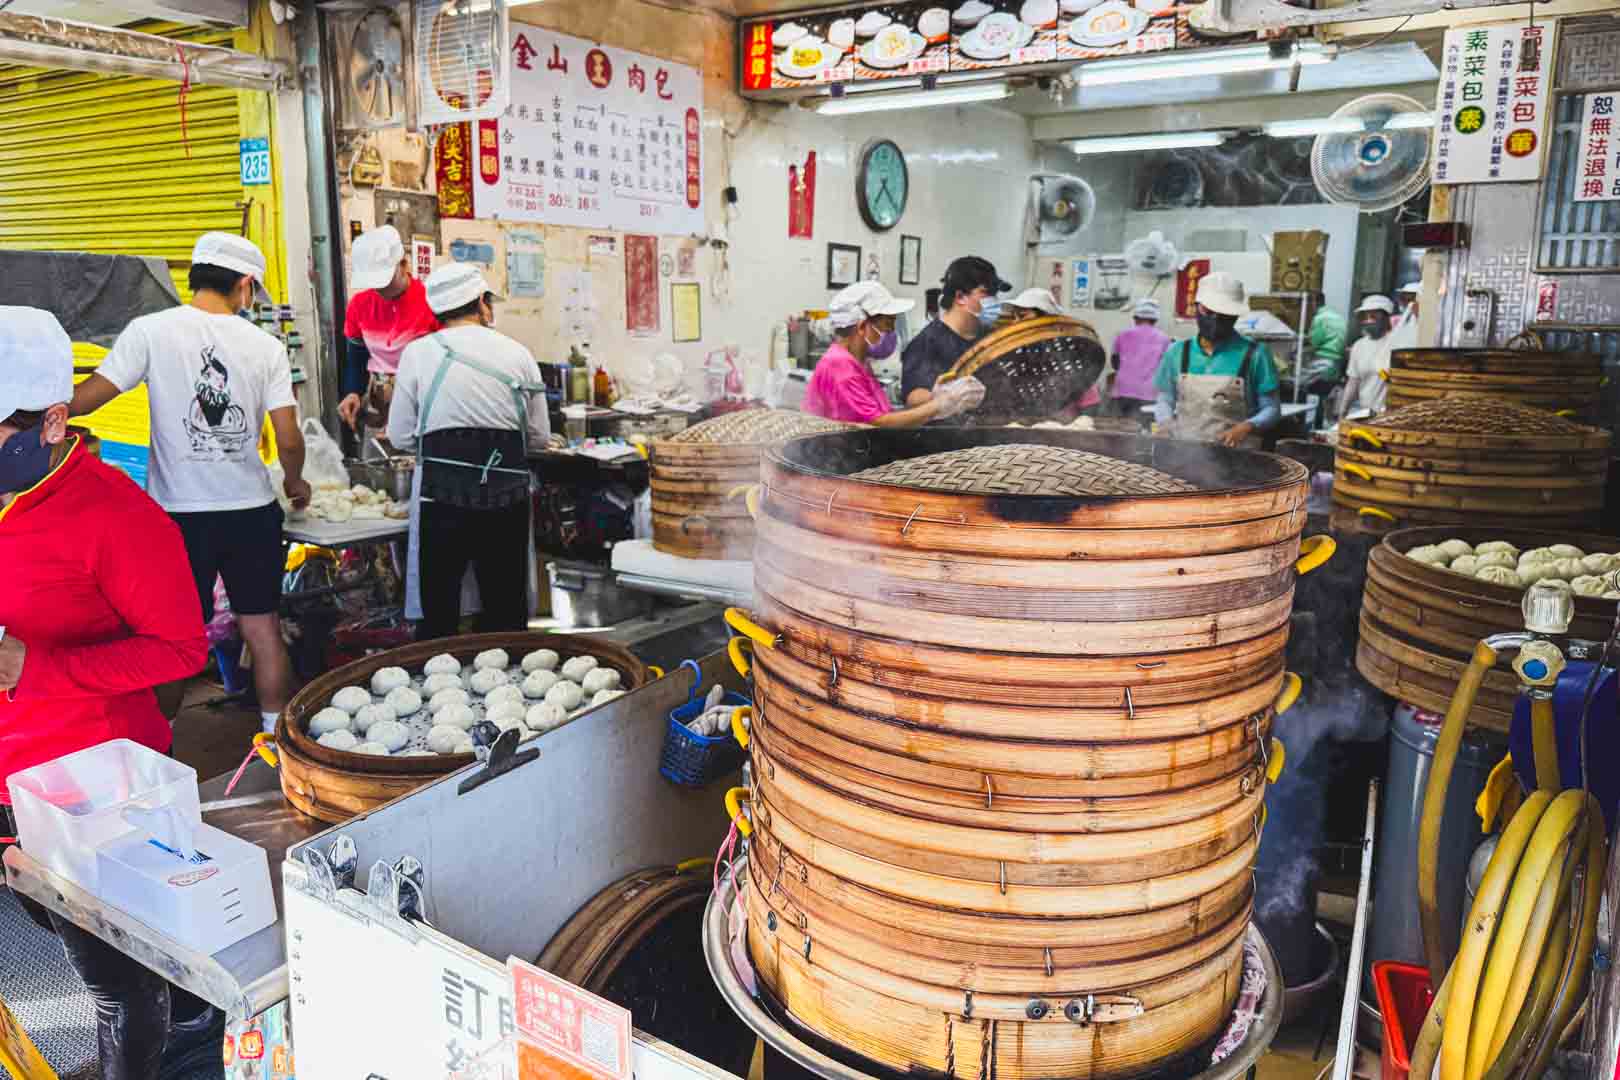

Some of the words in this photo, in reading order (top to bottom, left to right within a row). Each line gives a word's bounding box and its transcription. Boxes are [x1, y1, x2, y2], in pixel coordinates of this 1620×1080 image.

[1462, 31, 1488, 101] 素菜包
[245, 154, 268, 179] 235
[1583, 96, 1613, 197] 恕無法退換
